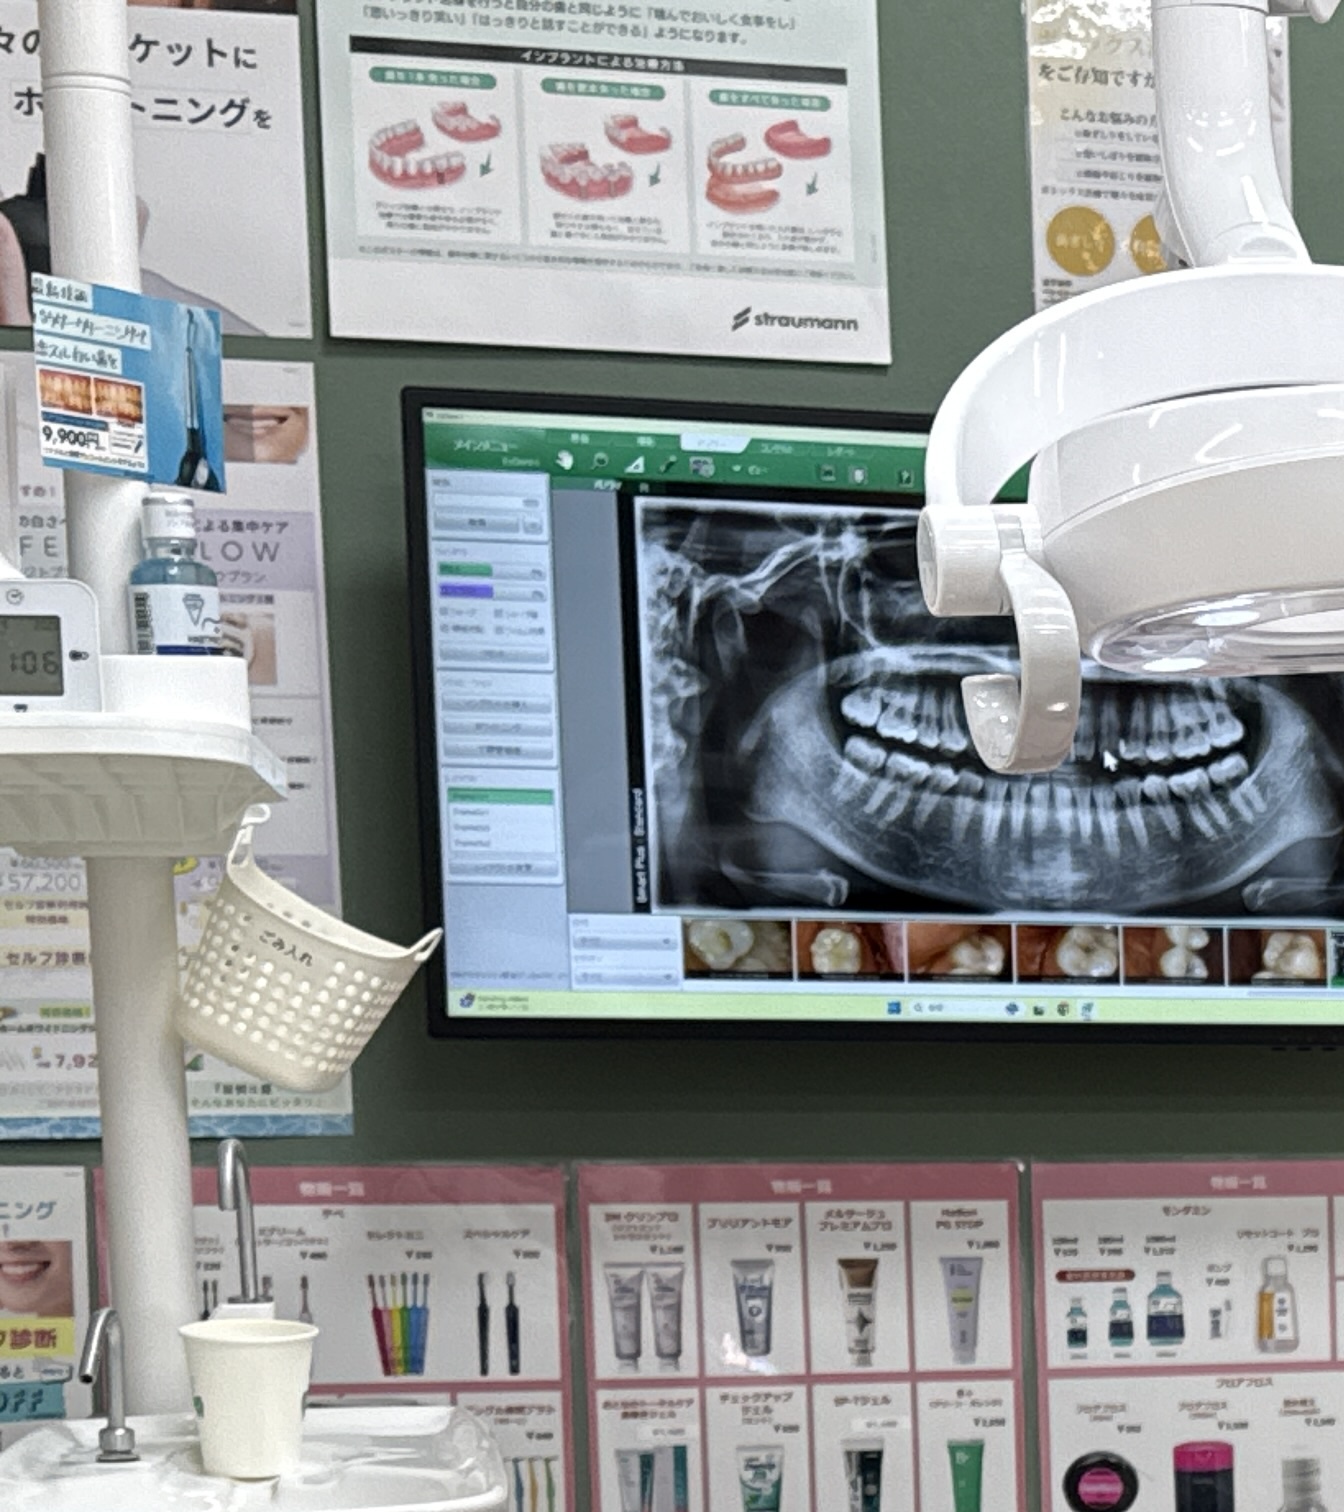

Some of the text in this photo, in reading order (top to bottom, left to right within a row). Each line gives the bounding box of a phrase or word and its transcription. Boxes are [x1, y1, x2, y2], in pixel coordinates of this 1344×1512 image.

[753, 311, 859, 333] straumann
[259, 930, 316, 968] ごみ入れ
